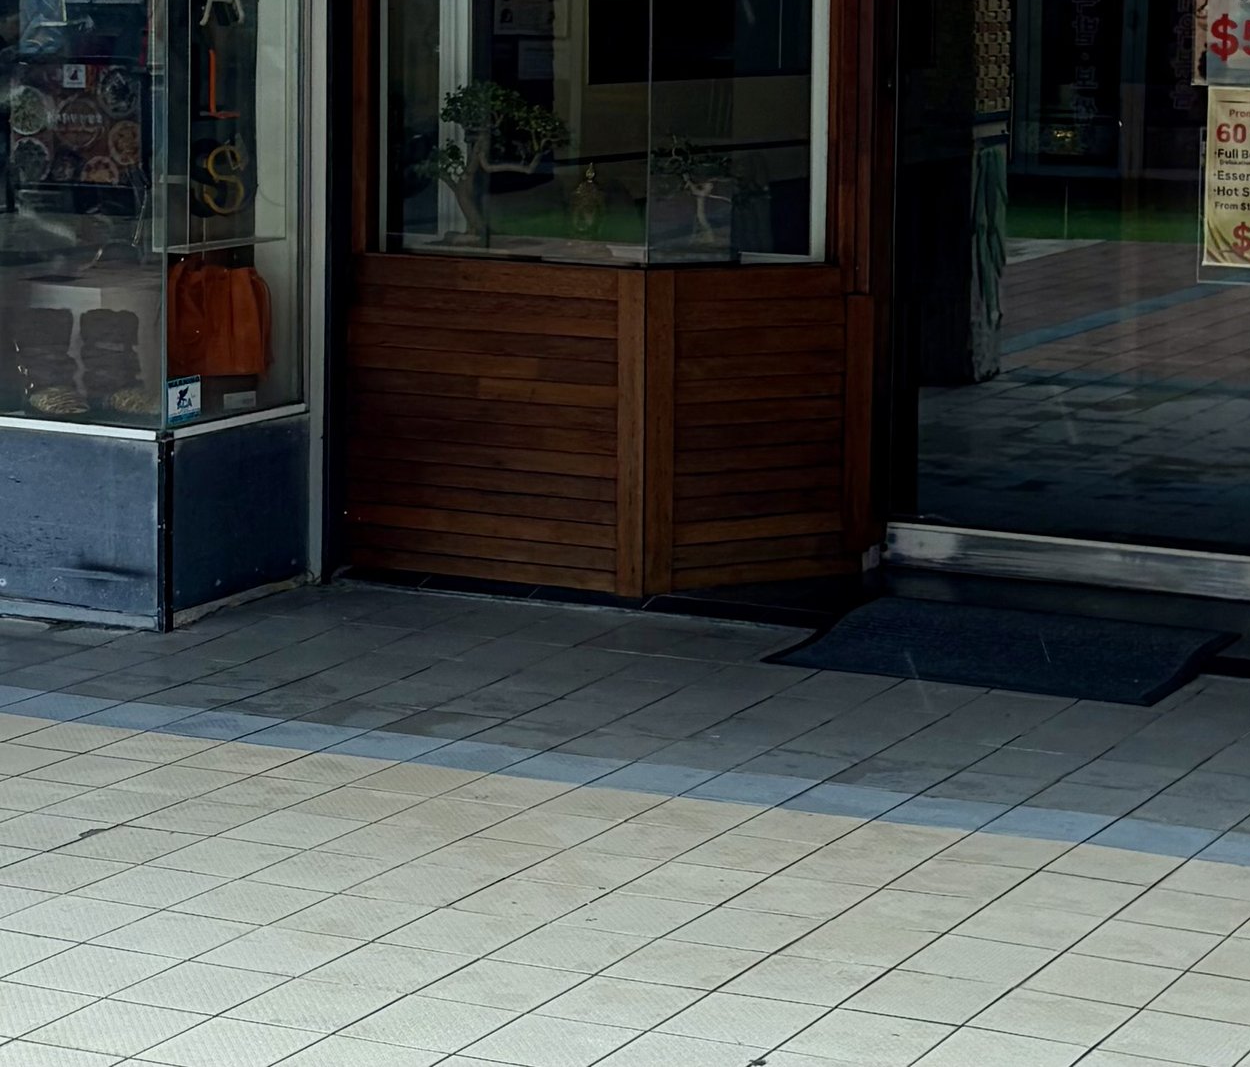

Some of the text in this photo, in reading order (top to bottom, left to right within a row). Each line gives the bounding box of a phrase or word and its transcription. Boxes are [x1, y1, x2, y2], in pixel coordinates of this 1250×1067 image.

[1216, 123, 1247, 143] 60
[1217, 148, 1239, 159] Full
[1217, 187, 1238, 197] Hot
[1214, 201, 1238, 210] From
